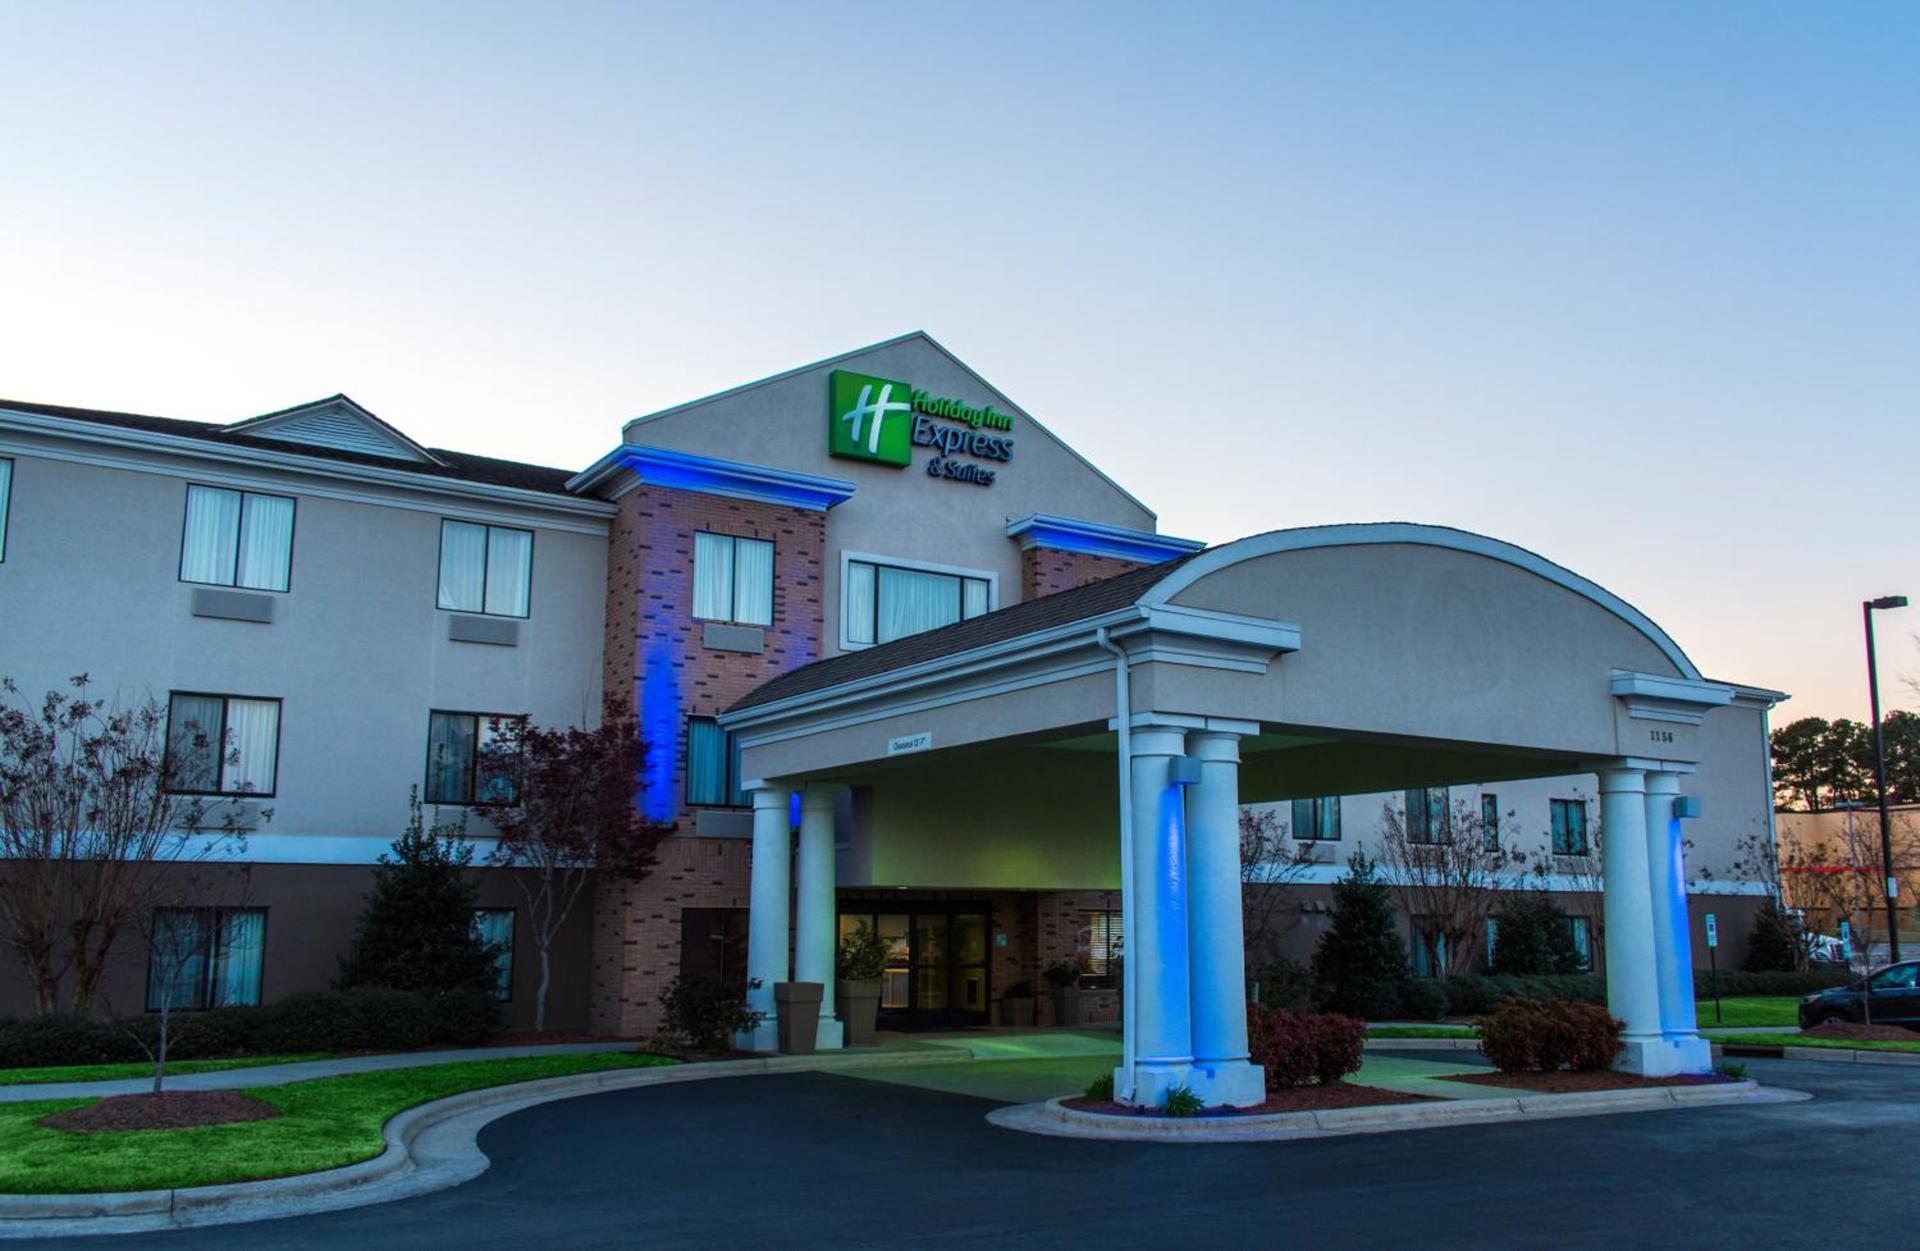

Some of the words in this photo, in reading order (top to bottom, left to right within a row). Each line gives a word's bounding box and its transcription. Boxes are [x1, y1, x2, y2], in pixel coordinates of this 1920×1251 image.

[912, 390, 984, 428] Holiday
[984, 404, 1015, 432] Inn
[912, 415, 1015, 462] Express
[927, 457, 943, 478] &
[944, 460, 996, 486] Suites
[1650, 730, 1673, 743] 1156
